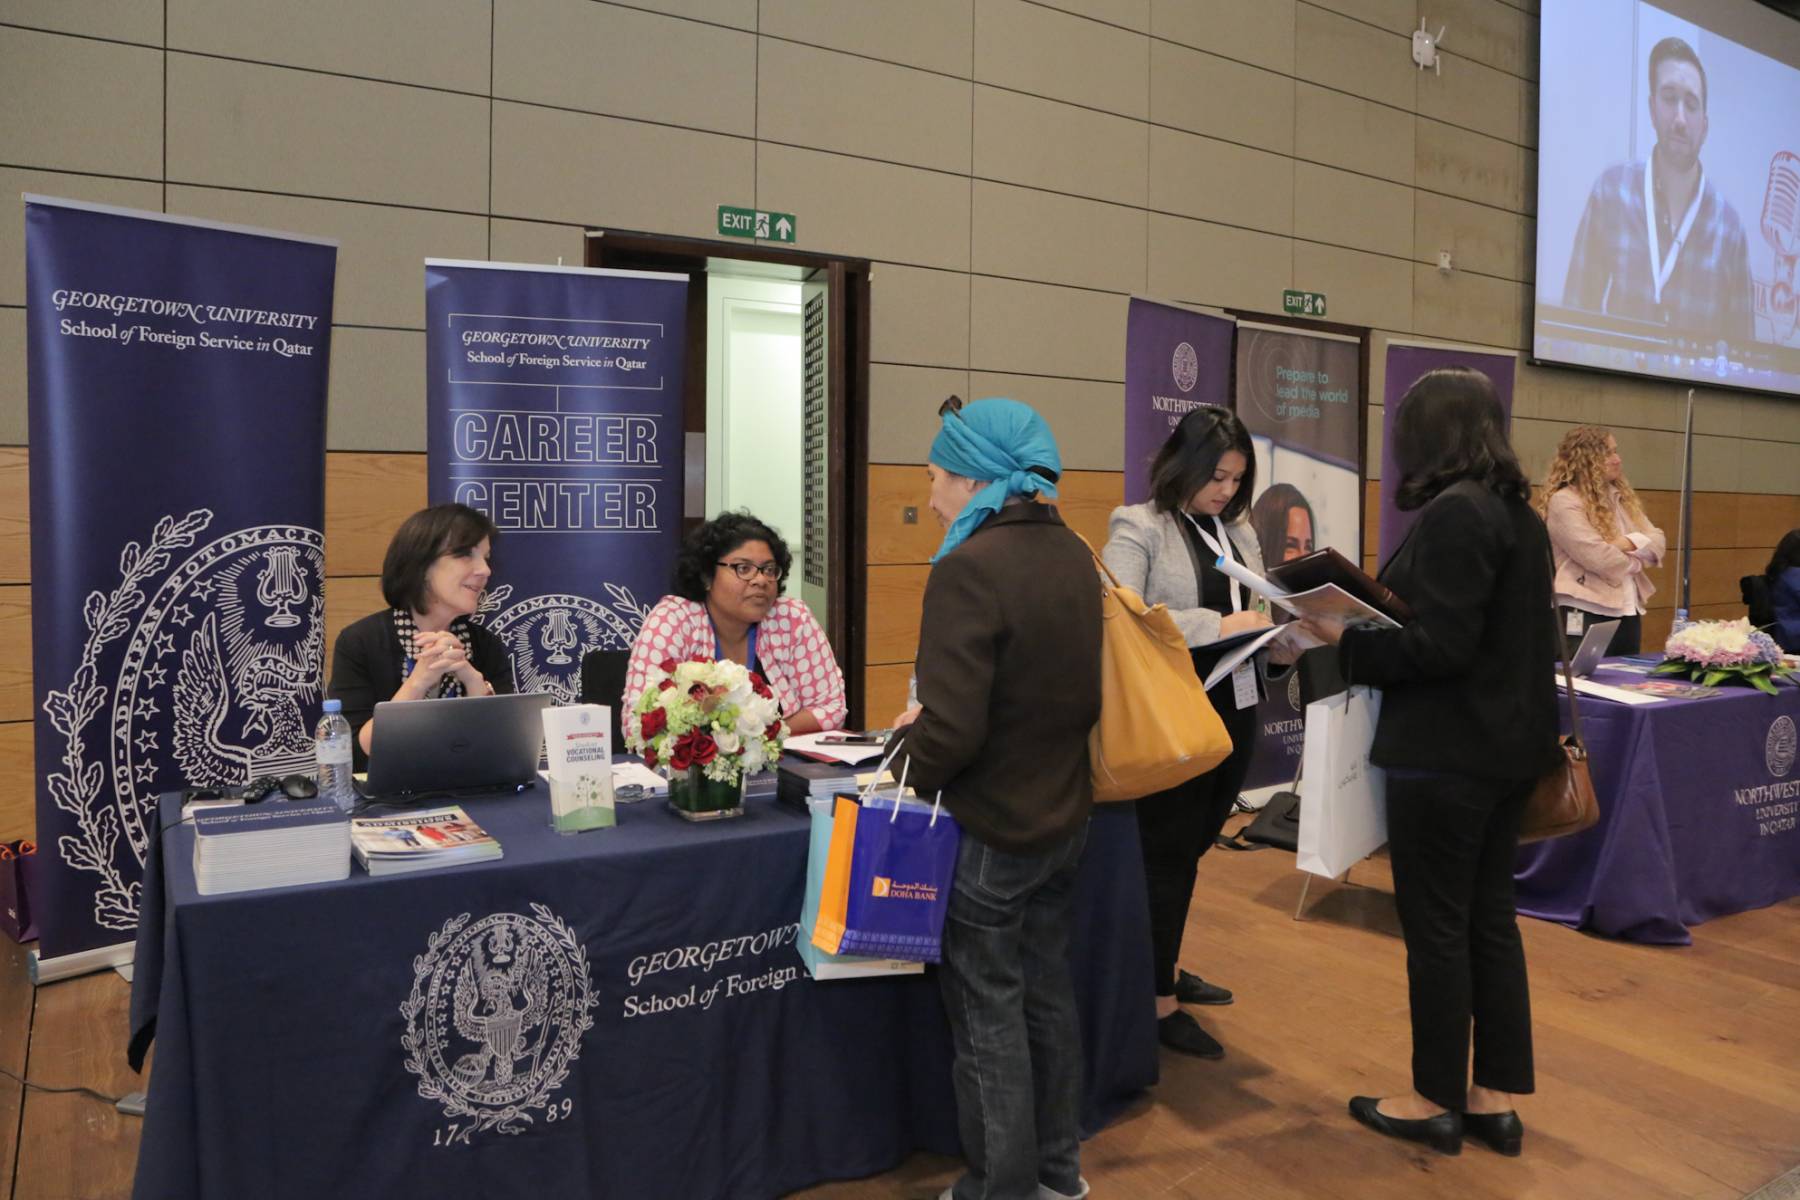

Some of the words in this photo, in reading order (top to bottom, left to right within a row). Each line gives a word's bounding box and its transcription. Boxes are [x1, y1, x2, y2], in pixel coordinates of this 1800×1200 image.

[723, 213, 752, 230] EXIT
[52, 289, 205, 324] GEORGETOWN
[206, 305, 318, 330] UNIVERSITY
[1286, 295, 1303, 308] EXIT
[60, 318, 117, 341] School
[120, 325, 137, 345] of
[139, 327, 196, 350] Foreign
[199, 332, 254, 351] Service
[256, 338, 270, 352] in
[273, 338, 313, 358] Qatar
[462, 330, 567, 351] GEORGETOWN
[567, 335, 650, 351] UNIVERSITY
[467, 351, 505, 364] School
[506, 353, 519, 367] of
[519, 353, 560, 369] Foreign
[562, 355, 602, 369] Service
[603, 356, 614, 368] in
[615, 357, 647, 371] Qatar
[1276, 366, 1315, 383] Prepare
[1318, 371, 1328, 384] to
[1276, 383, 1298, 399] lead
[1301, 386, 1316, 400] the
[1320, 389, 1349, 403] world
[1288, 403, 1320, 418] media
[453, 412, 658, 463] CAREER
[167, 529, 313, 593] POTOMACI
[494, 597, 580, 629] OTOMACI
[1733, 780, 1800, 805] NORTHWEST
[891, 889, 913, 899] DOHA
[914, 891, 937, 901] BANK
[623, 985, 697, 1019] School
[699, 980, 723, 1011] of
[726, 963, 798, 998] Foreign
[546, 1097, 572, 1122] 89
[433, 1123, 459, 1146] 17
